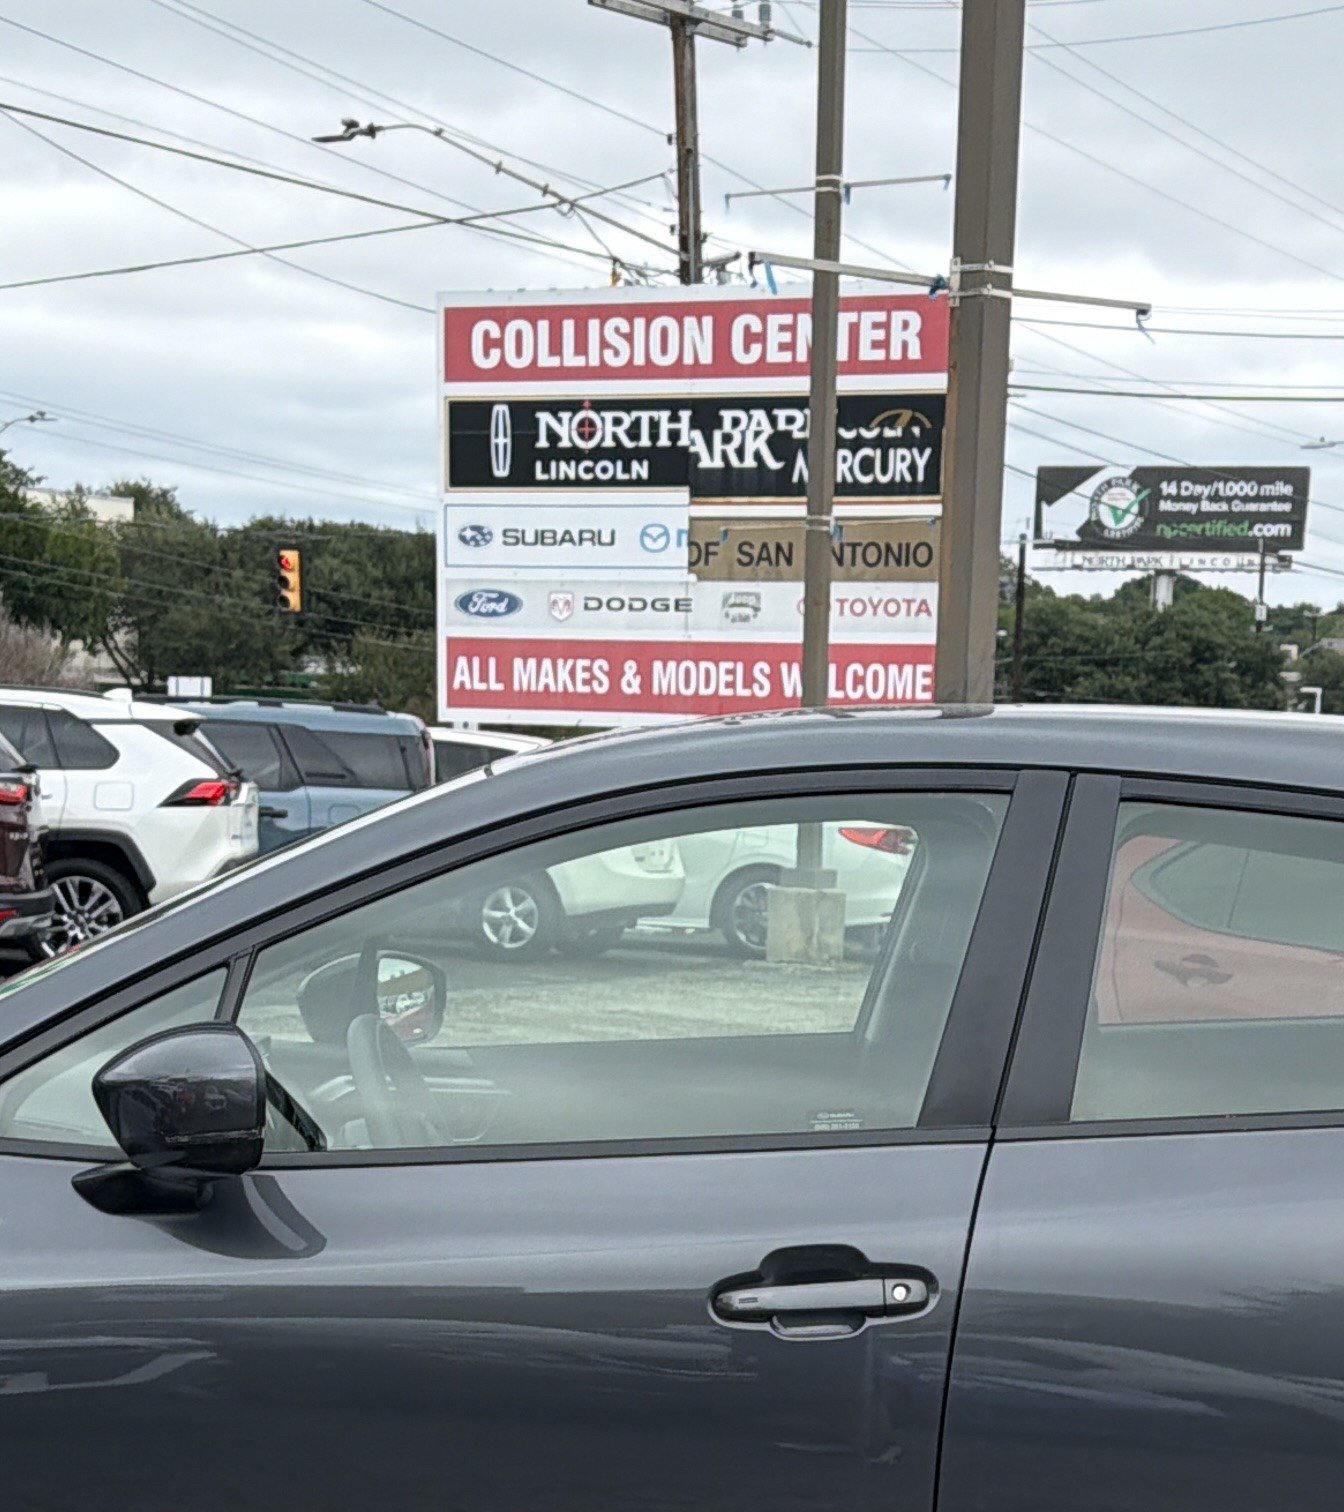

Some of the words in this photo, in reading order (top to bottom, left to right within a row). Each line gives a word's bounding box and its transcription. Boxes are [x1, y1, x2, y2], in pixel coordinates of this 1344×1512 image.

[470, 314, 713, 370] COLLISION
[534, 407, 692, 450] NORTH
[535, 460, 649, 481] LINCOLN
[791, 447, 932, 484] MRCURY
[1159, 481, 1177, 497] 14
[1259, 480, 1294, 497] mile
[1158, 500, 1198, 515] Money
[1200, 500, 1229, 512] Back
[501, 528, 616, 547] SUBARU
[737, 541, 794, 568] SAN
[831, 540, 934, 568] NTONIO
[468, 591, 509, 613] Ford
[583, 596, 694, 613] DODGE
[835, 597, 933, 618] TOYOTA
[453, 656, 505, 691] ALL
[513, 657, 610, 694] MAKES
[620, 659, 642, 695] &
[652, 660, 772, 698] MODELS
[780, 661, 934, 701] WLCOME
